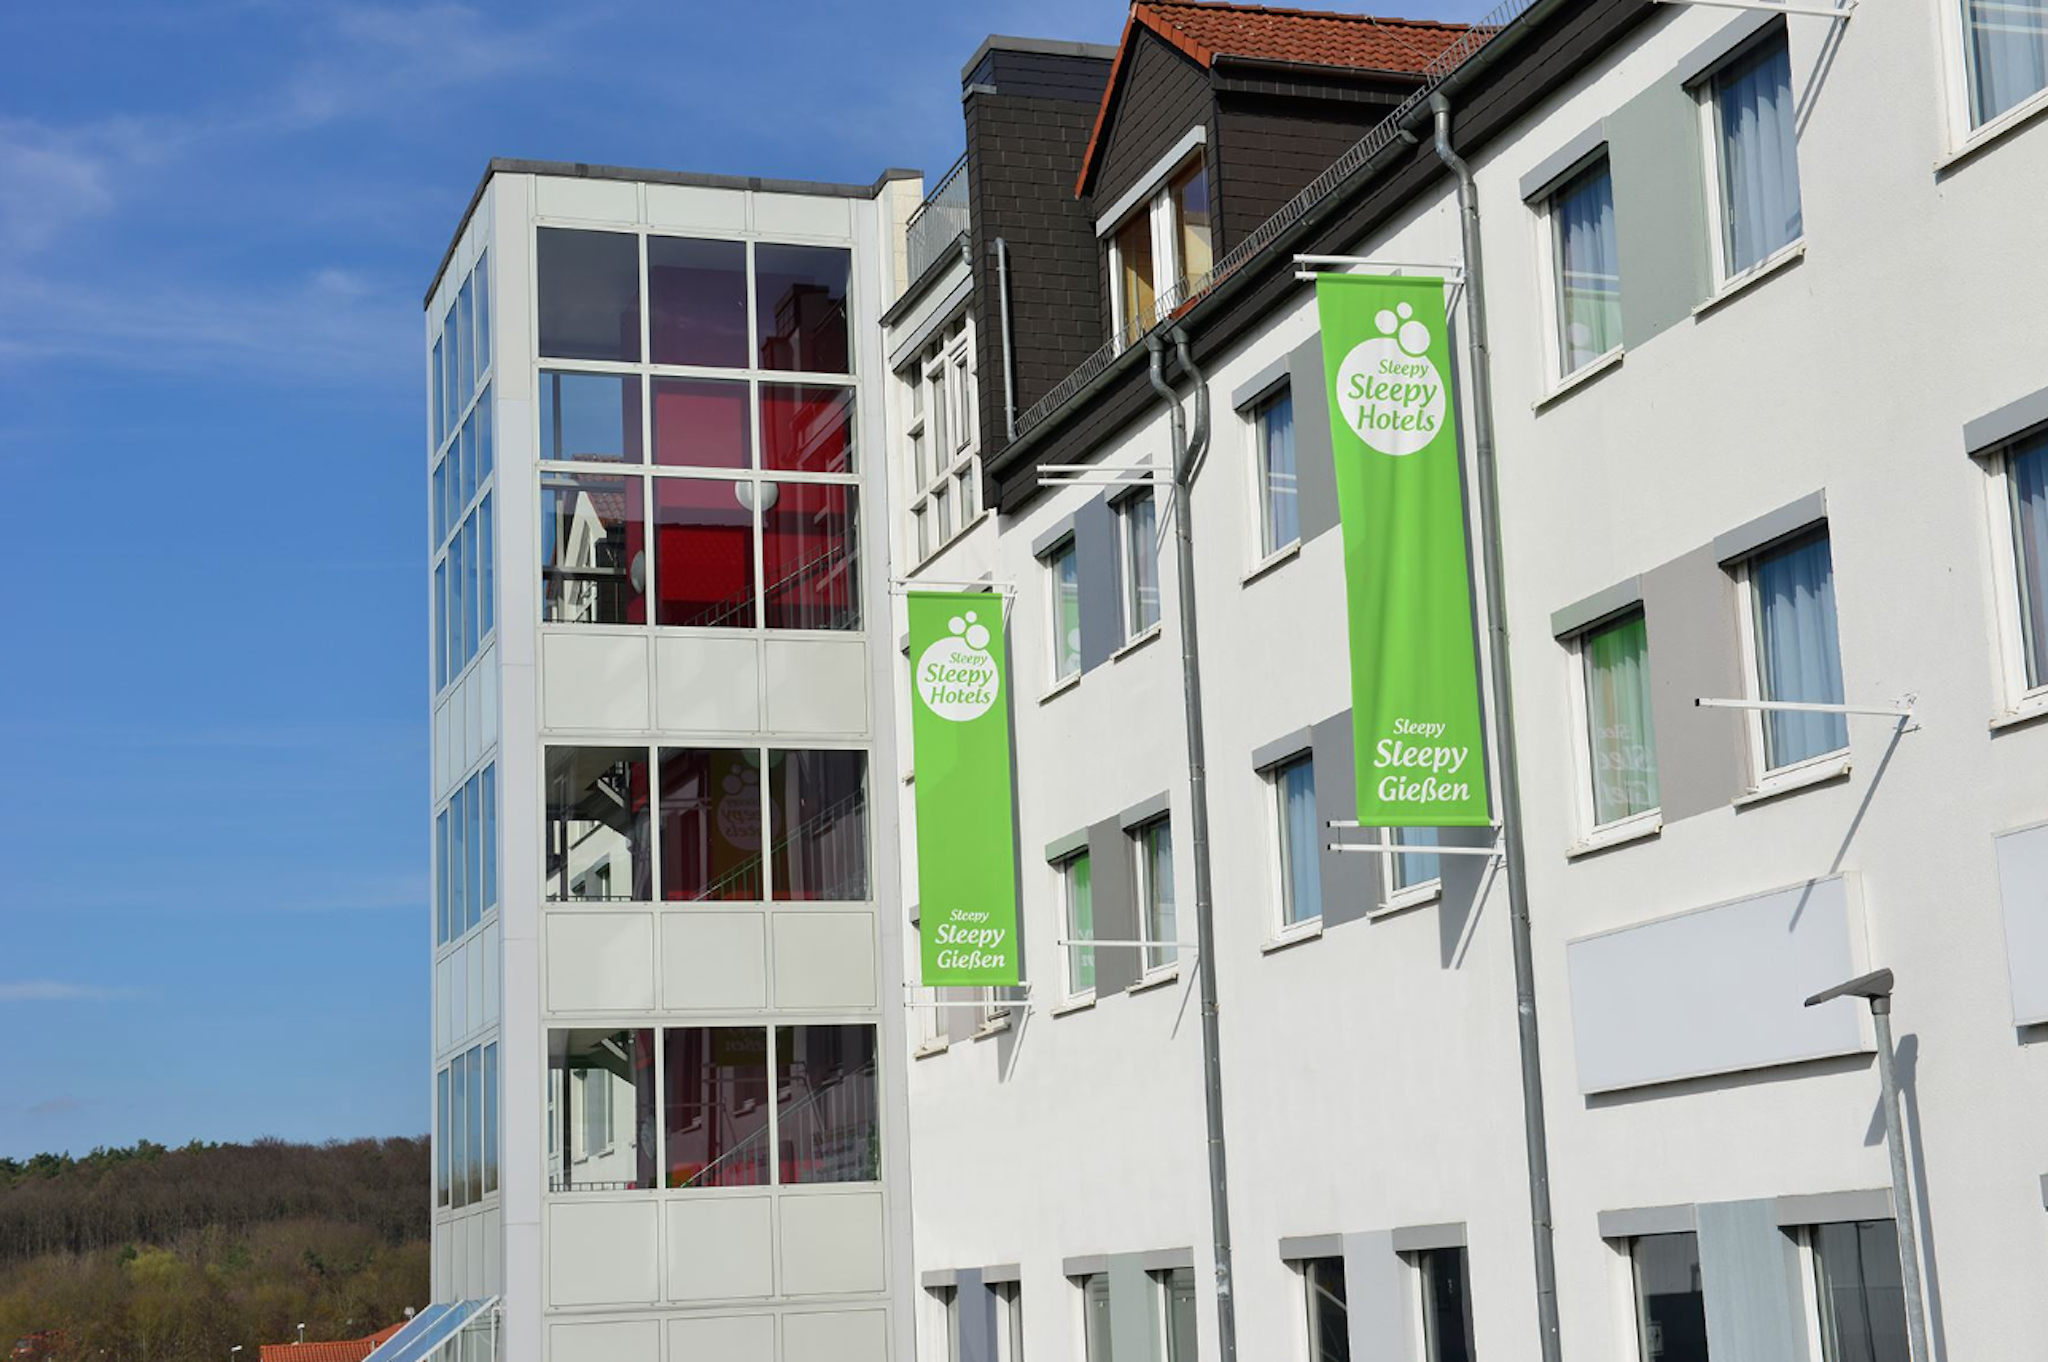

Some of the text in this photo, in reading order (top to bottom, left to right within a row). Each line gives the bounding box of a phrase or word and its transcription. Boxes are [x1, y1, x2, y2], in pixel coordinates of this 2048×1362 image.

[1378, 359, 1429, 378] Sleepy
[1347, 373, 1438, 408] Sleepy
[1357, 403, 1435, 432] Hotels
[949, 651, 988, 667] Sleepy
[924, 663, 994, 688] Sleepy
[930, 685, 992, 705] Hotels
[1393, 717, 1446, 739] Sleepy
[1373, 738, 1469, 774] Sleepy
[1378, 775, 1471, 804] Gießen
[949, 908, 990, 924] Sleepy
[934, 923, 1006, 948] Sleepy
[937, 949, 1006, 970] Gießen
